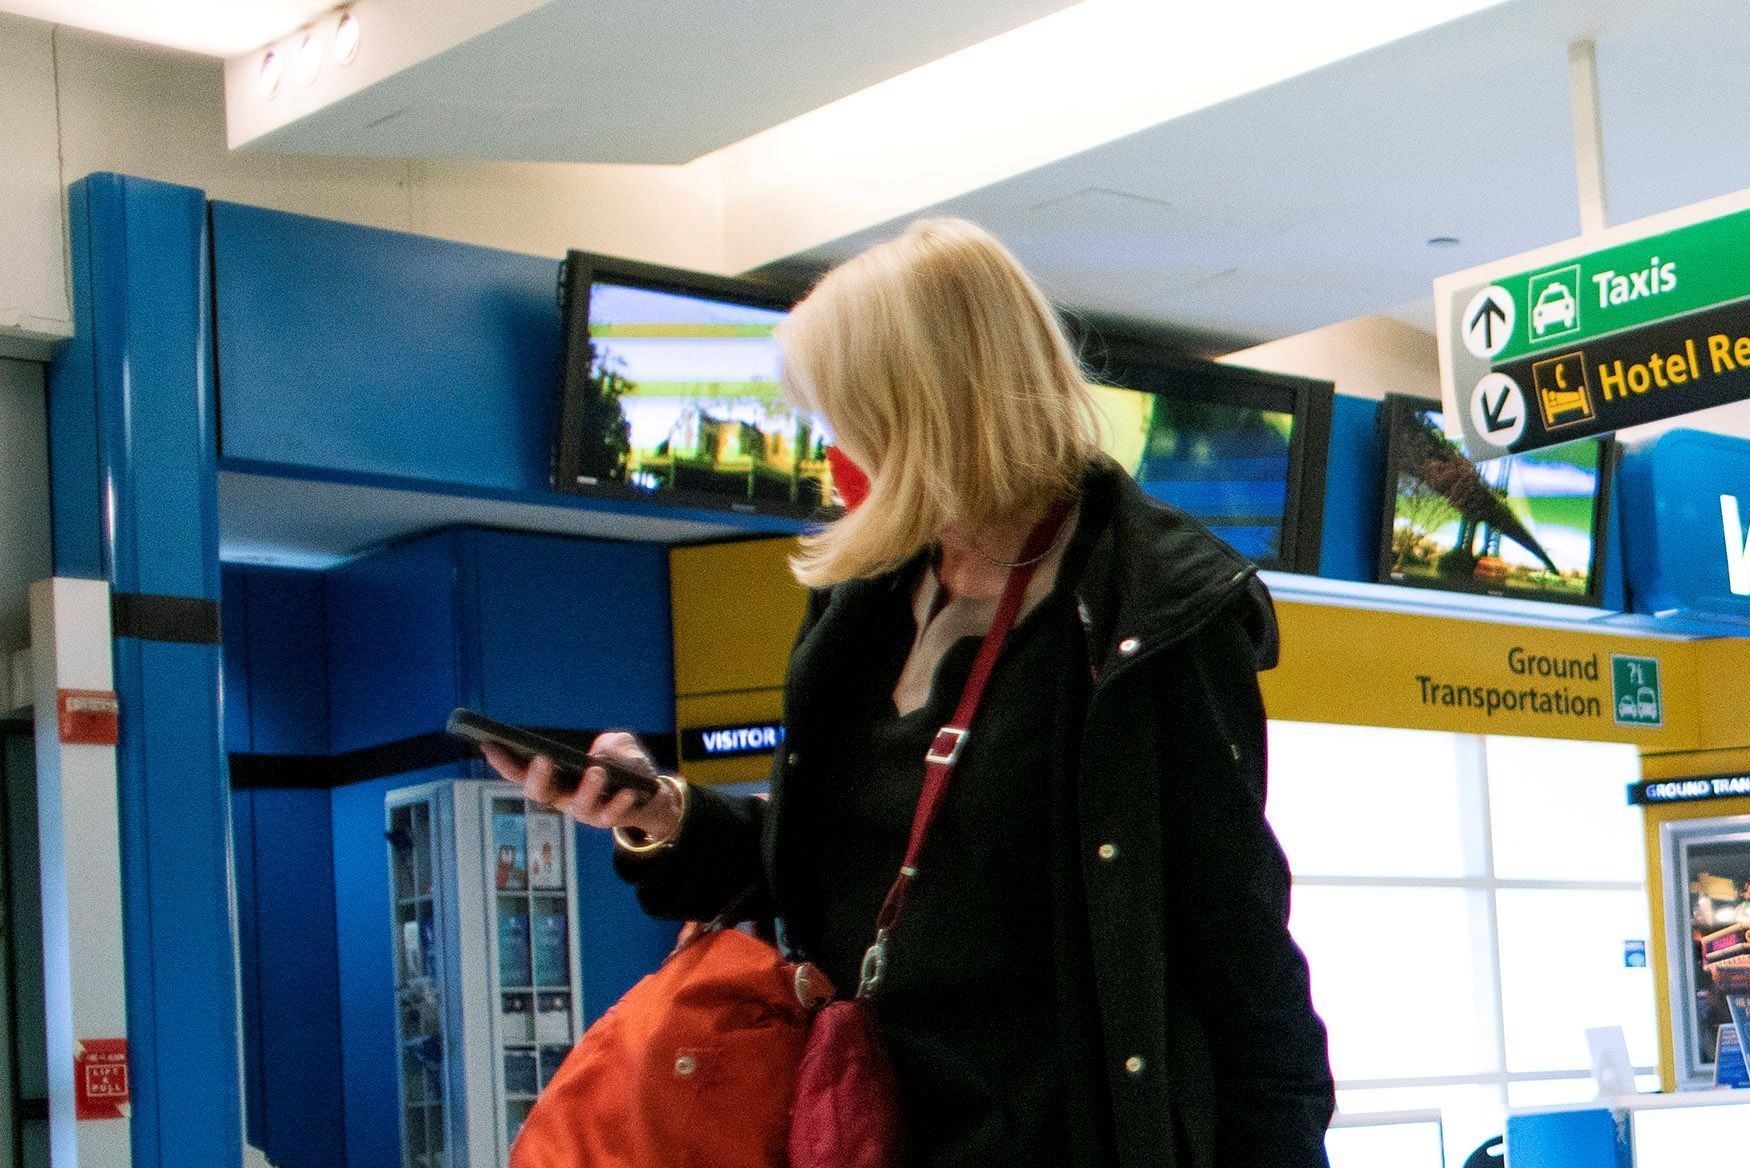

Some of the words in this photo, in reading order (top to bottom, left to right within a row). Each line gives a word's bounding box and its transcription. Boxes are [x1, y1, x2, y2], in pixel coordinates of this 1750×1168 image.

[1593, 256, 1677, 309] Taxis
[1599, 340, 1700, 401] Hotel
[1507, 646, 1600, 681] Ground
[1415, 674, 1601, 717] Transportation
[702, 727, 776, 753] VISITOR
[1646, 778, 1710, 799] GROUND
